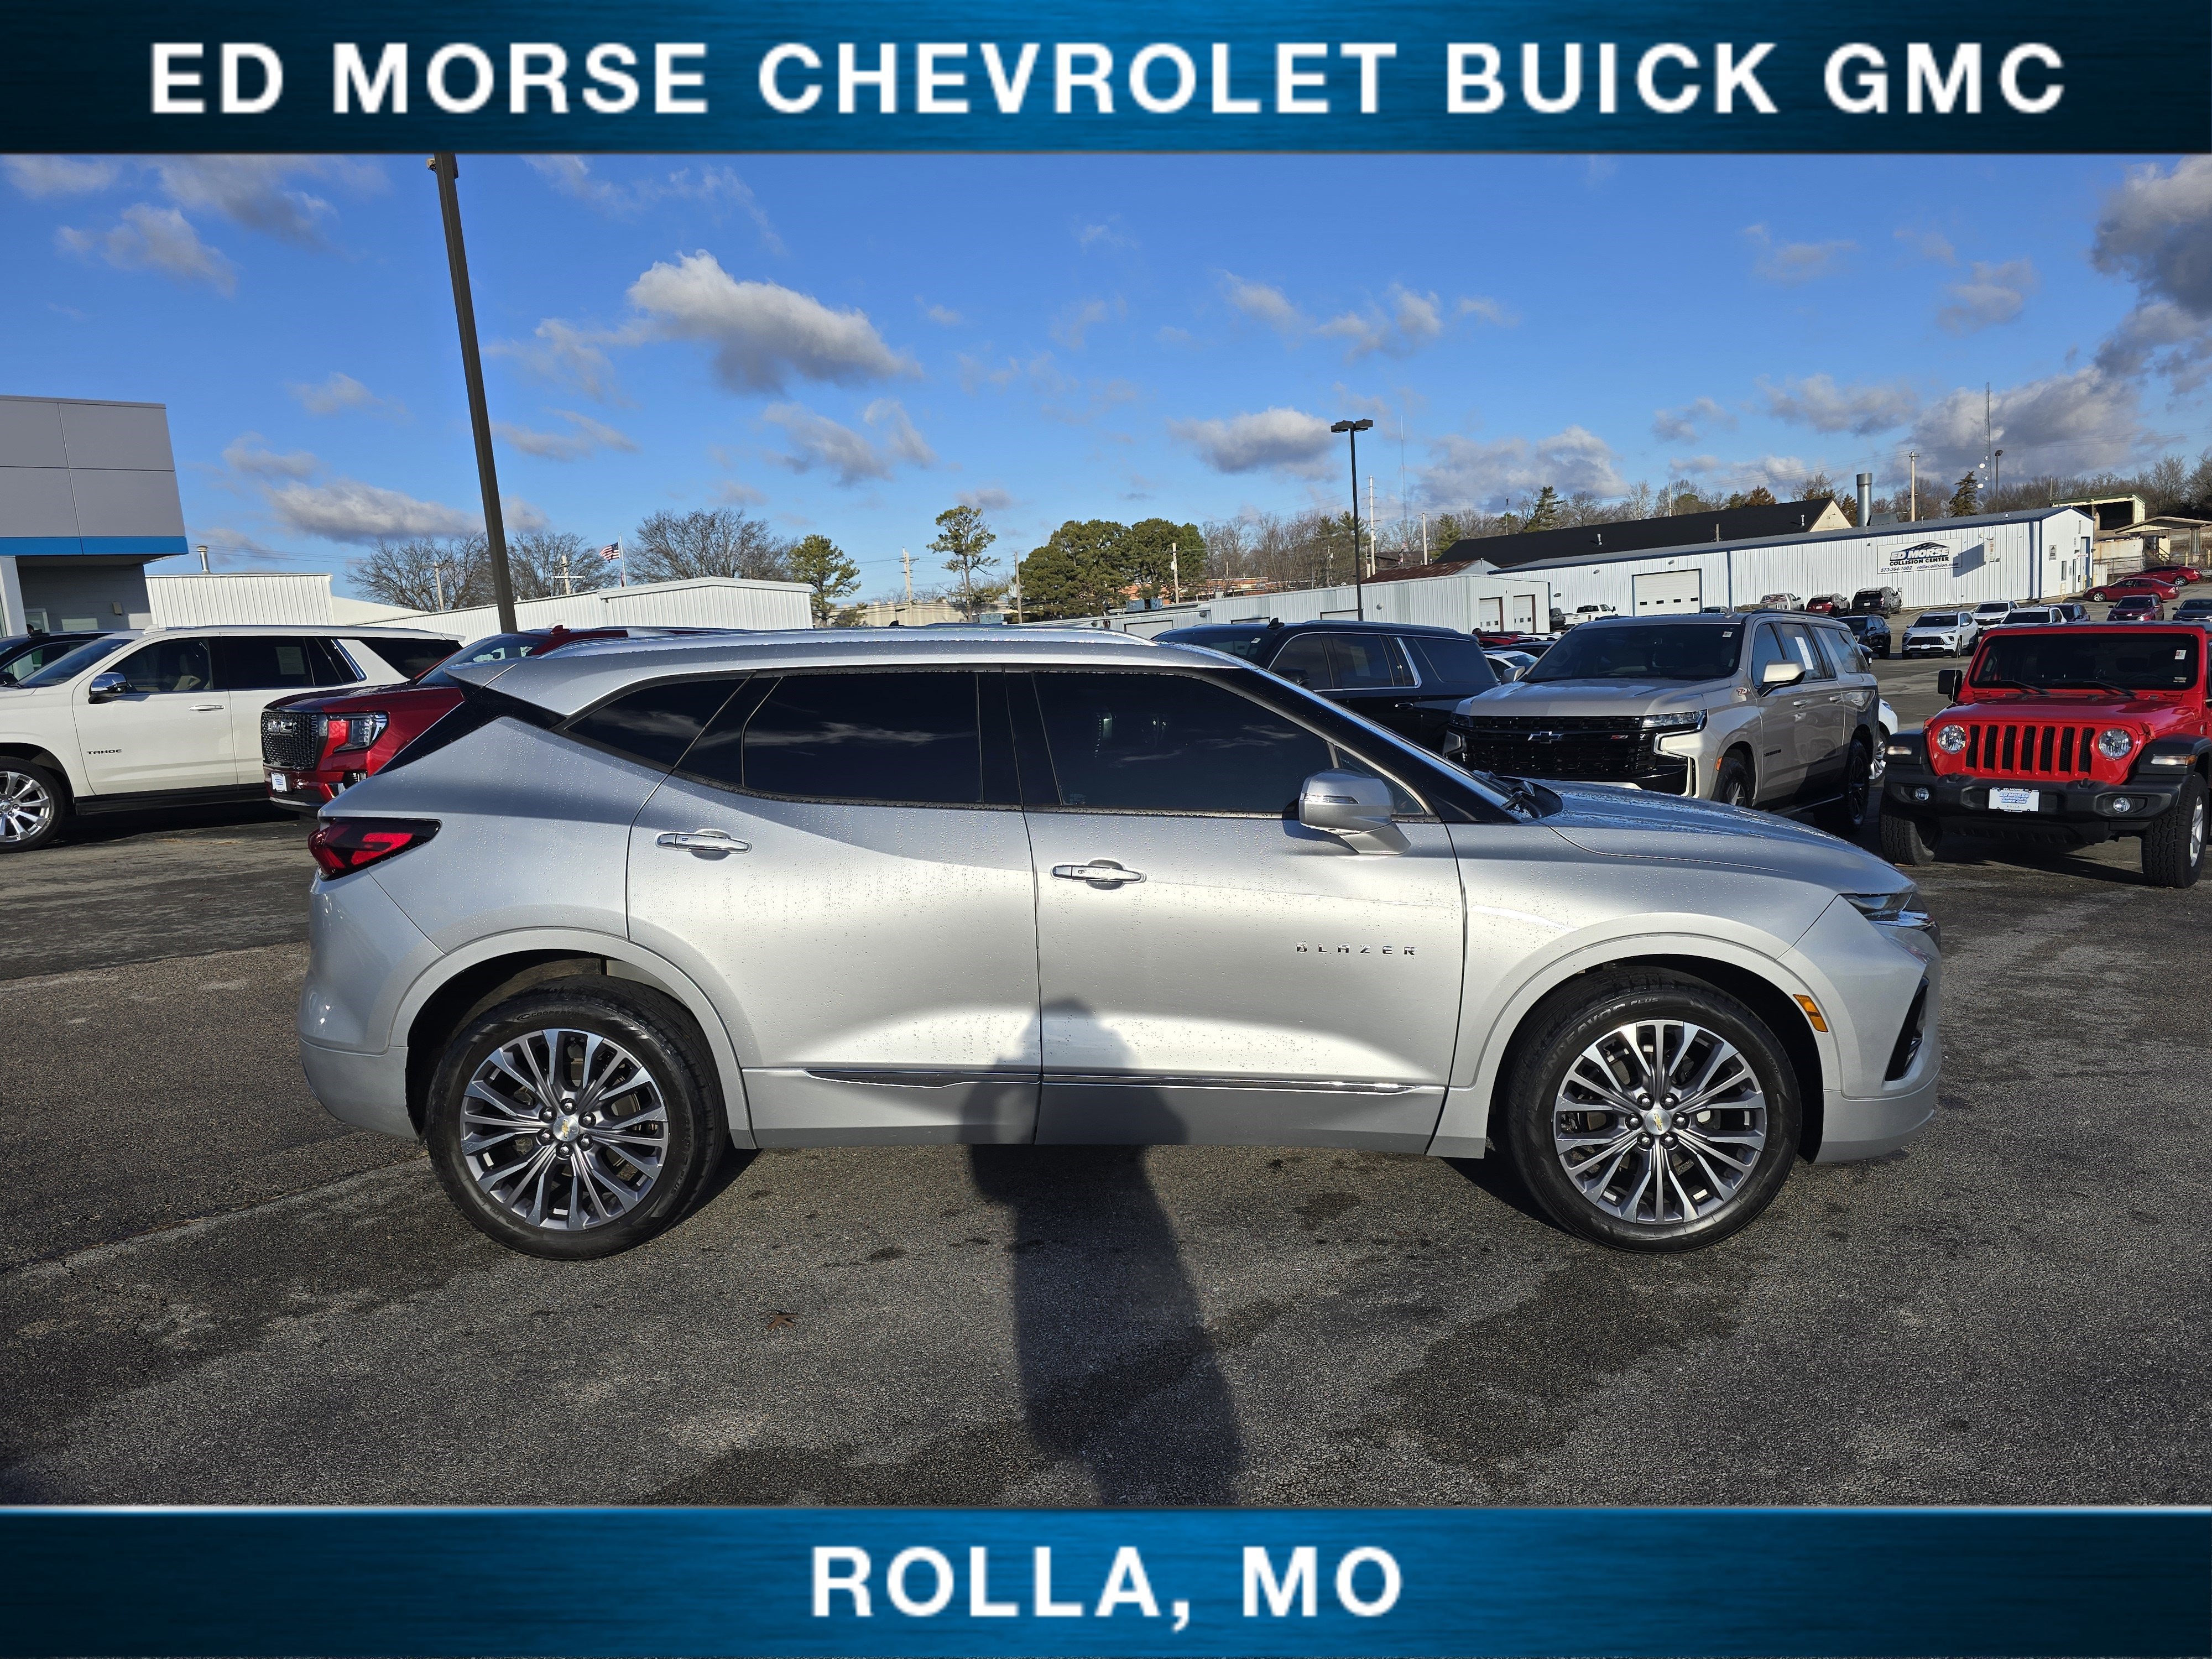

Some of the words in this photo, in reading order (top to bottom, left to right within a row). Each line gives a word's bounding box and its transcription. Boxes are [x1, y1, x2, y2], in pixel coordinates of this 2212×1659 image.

[1890, 551, 1906, 561] ED
[1907, 547, 1949, 560] MORSE
[1296, 943, 1416, 955] BLAZER
[1631, 997, 1659, 1006] PLUS
